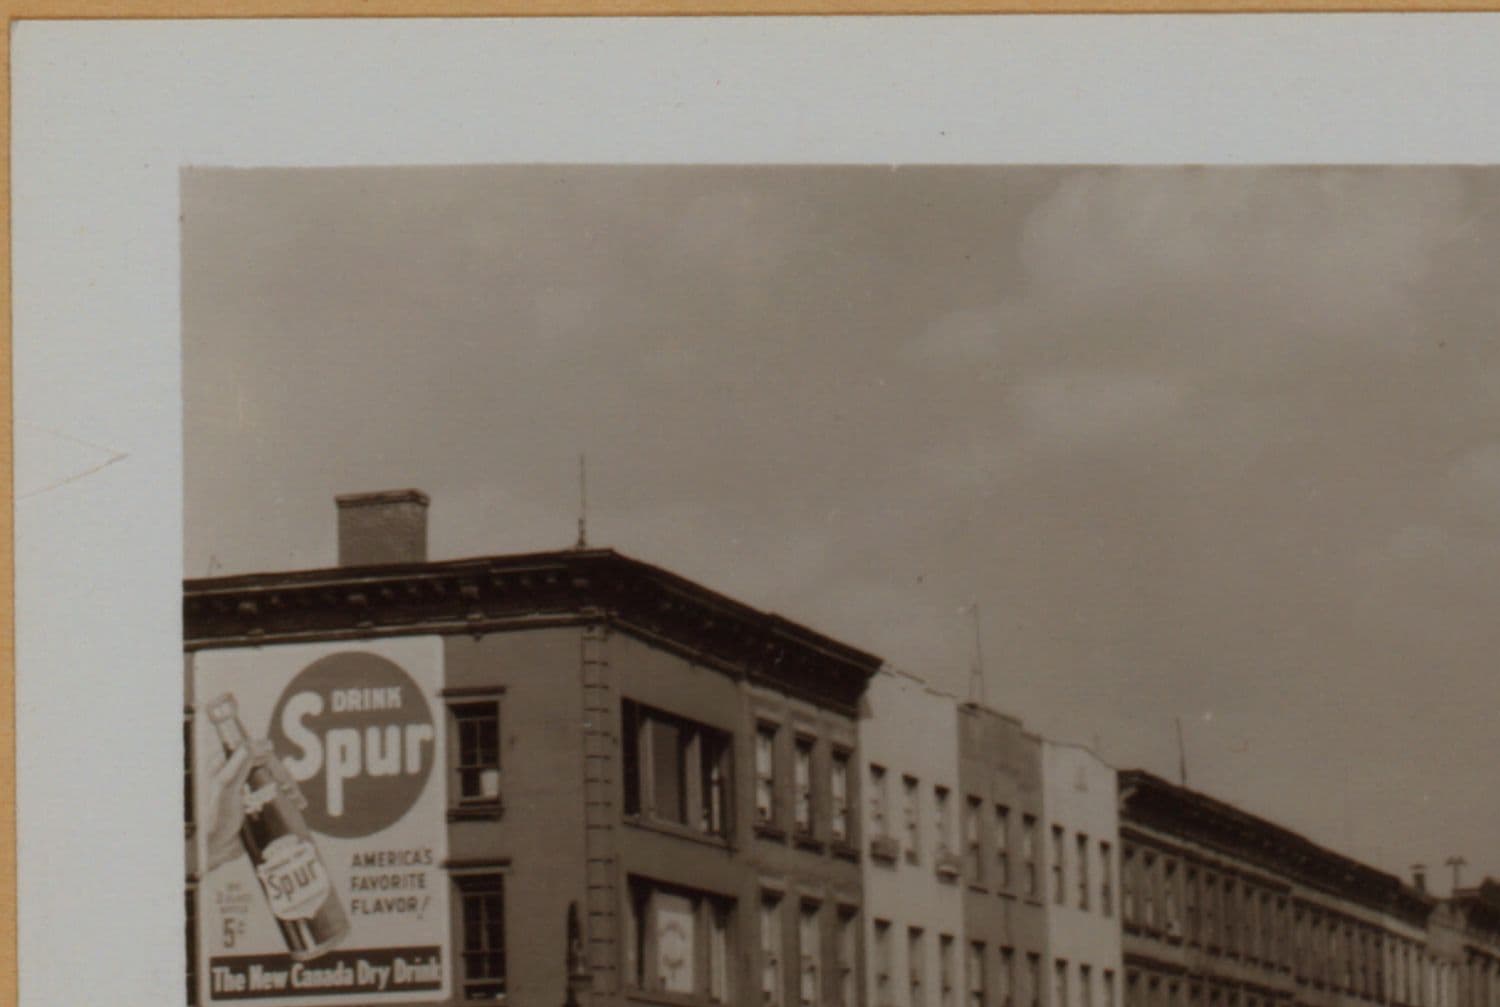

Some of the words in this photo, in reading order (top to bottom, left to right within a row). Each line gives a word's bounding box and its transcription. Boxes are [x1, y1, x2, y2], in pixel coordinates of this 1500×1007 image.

[332, 687, 401, 712] DRINK
[281, 691, 433, 817] Spur
[267, 859, 318, 902] Spur
[351, 872, 426, 891] FAVORITE
[351, 896, 431, 920] FLAVOR!
[212, 966, 246, 992] The
[249, 965, 288, 991] New
[291, 962, 354, 988] Canada
[357, 959, 390, 990] Dry
